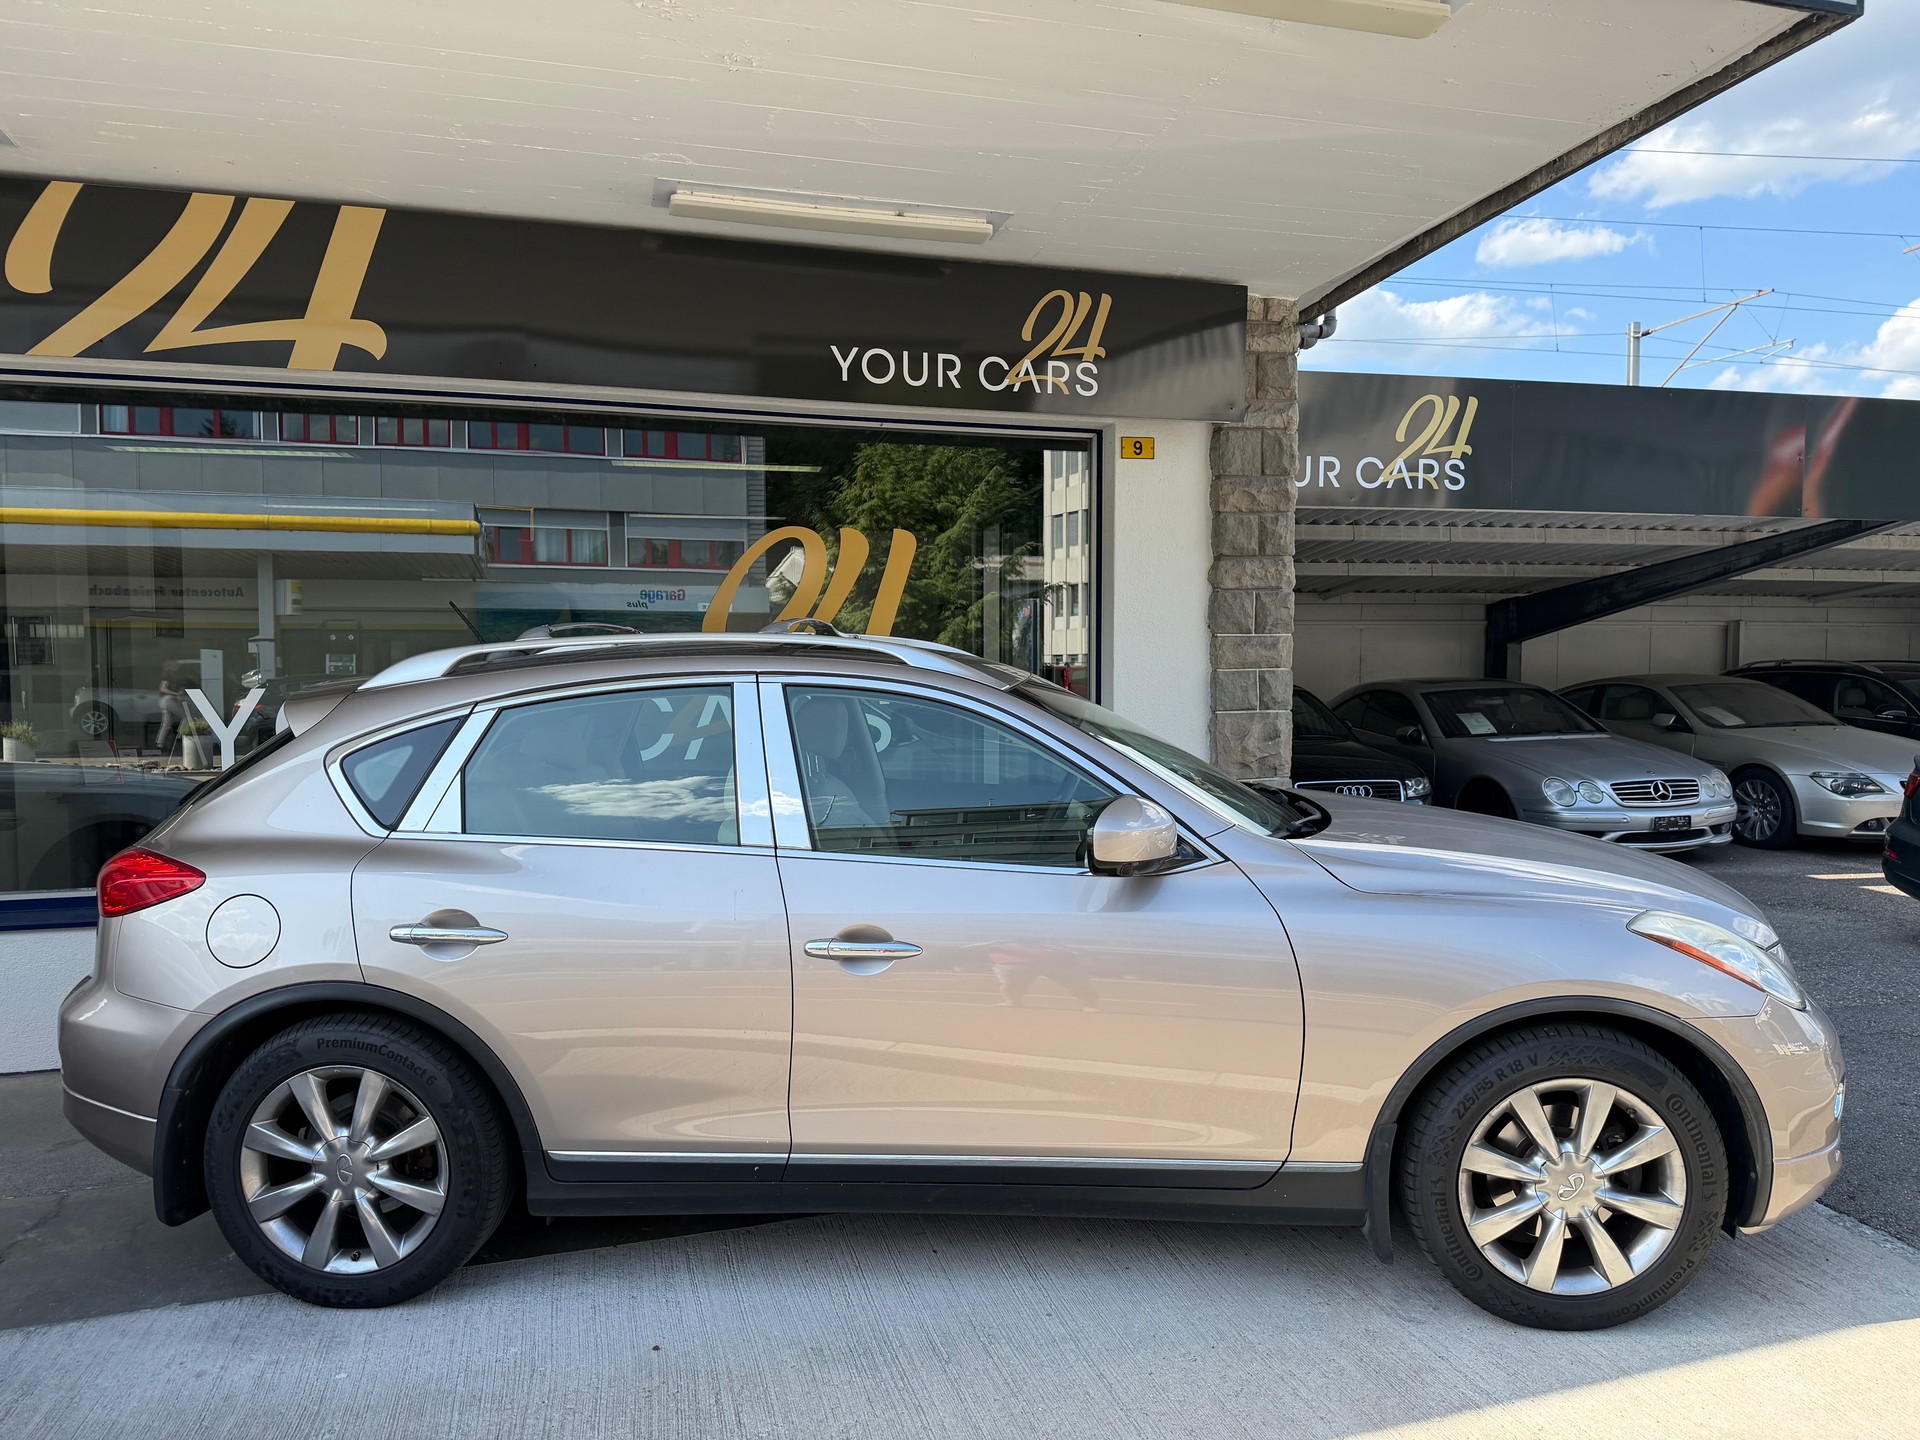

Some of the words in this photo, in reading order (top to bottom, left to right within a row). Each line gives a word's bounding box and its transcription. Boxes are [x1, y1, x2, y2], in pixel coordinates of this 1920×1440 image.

[5, 181, 387, 371] 24
[830, 345, 961, 389] YOUR
[978, 356, 1099, 397] CARS
[1006, 289, 1113, 395] 24
[1133, 440, 1143, 456] 9
[1294, 455, 1341, 488] UR
[1355, 456, 1466, 491] CARS
[1380, 394, 1479, 490] 24
[316, 1037, 427, 1078] PremiumContact
[425, 1075, 438, 1086] 6
[1452, 1076, 1494, 1119] 225/55
[1494, 1068, 1508, 1081] R
[1507, 1059, 1524, 1074] 18
[1526, 1053, 1538, 1066] V
[1665, 1093, 1717, 1187] Continental
